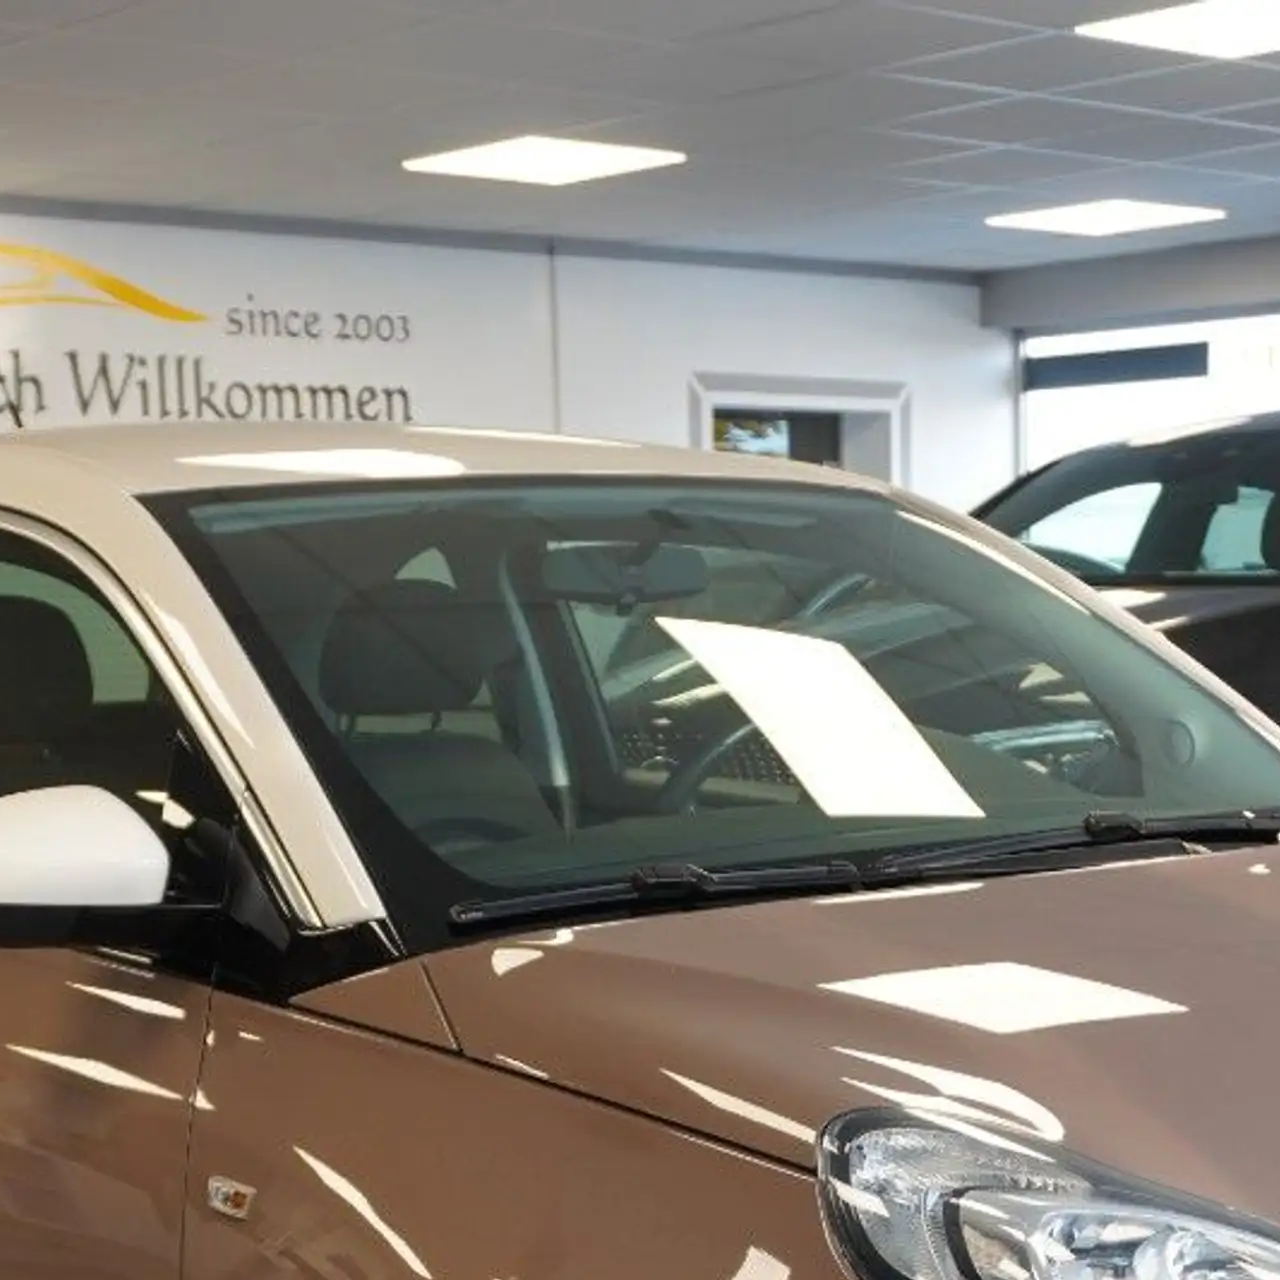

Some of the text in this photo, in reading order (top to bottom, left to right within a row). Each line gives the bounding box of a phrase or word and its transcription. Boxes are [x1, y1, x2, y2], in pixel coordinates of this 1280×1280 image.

[225, 293, 411, 343] since 2003
[63, 348, 414, 422] Willkommen
